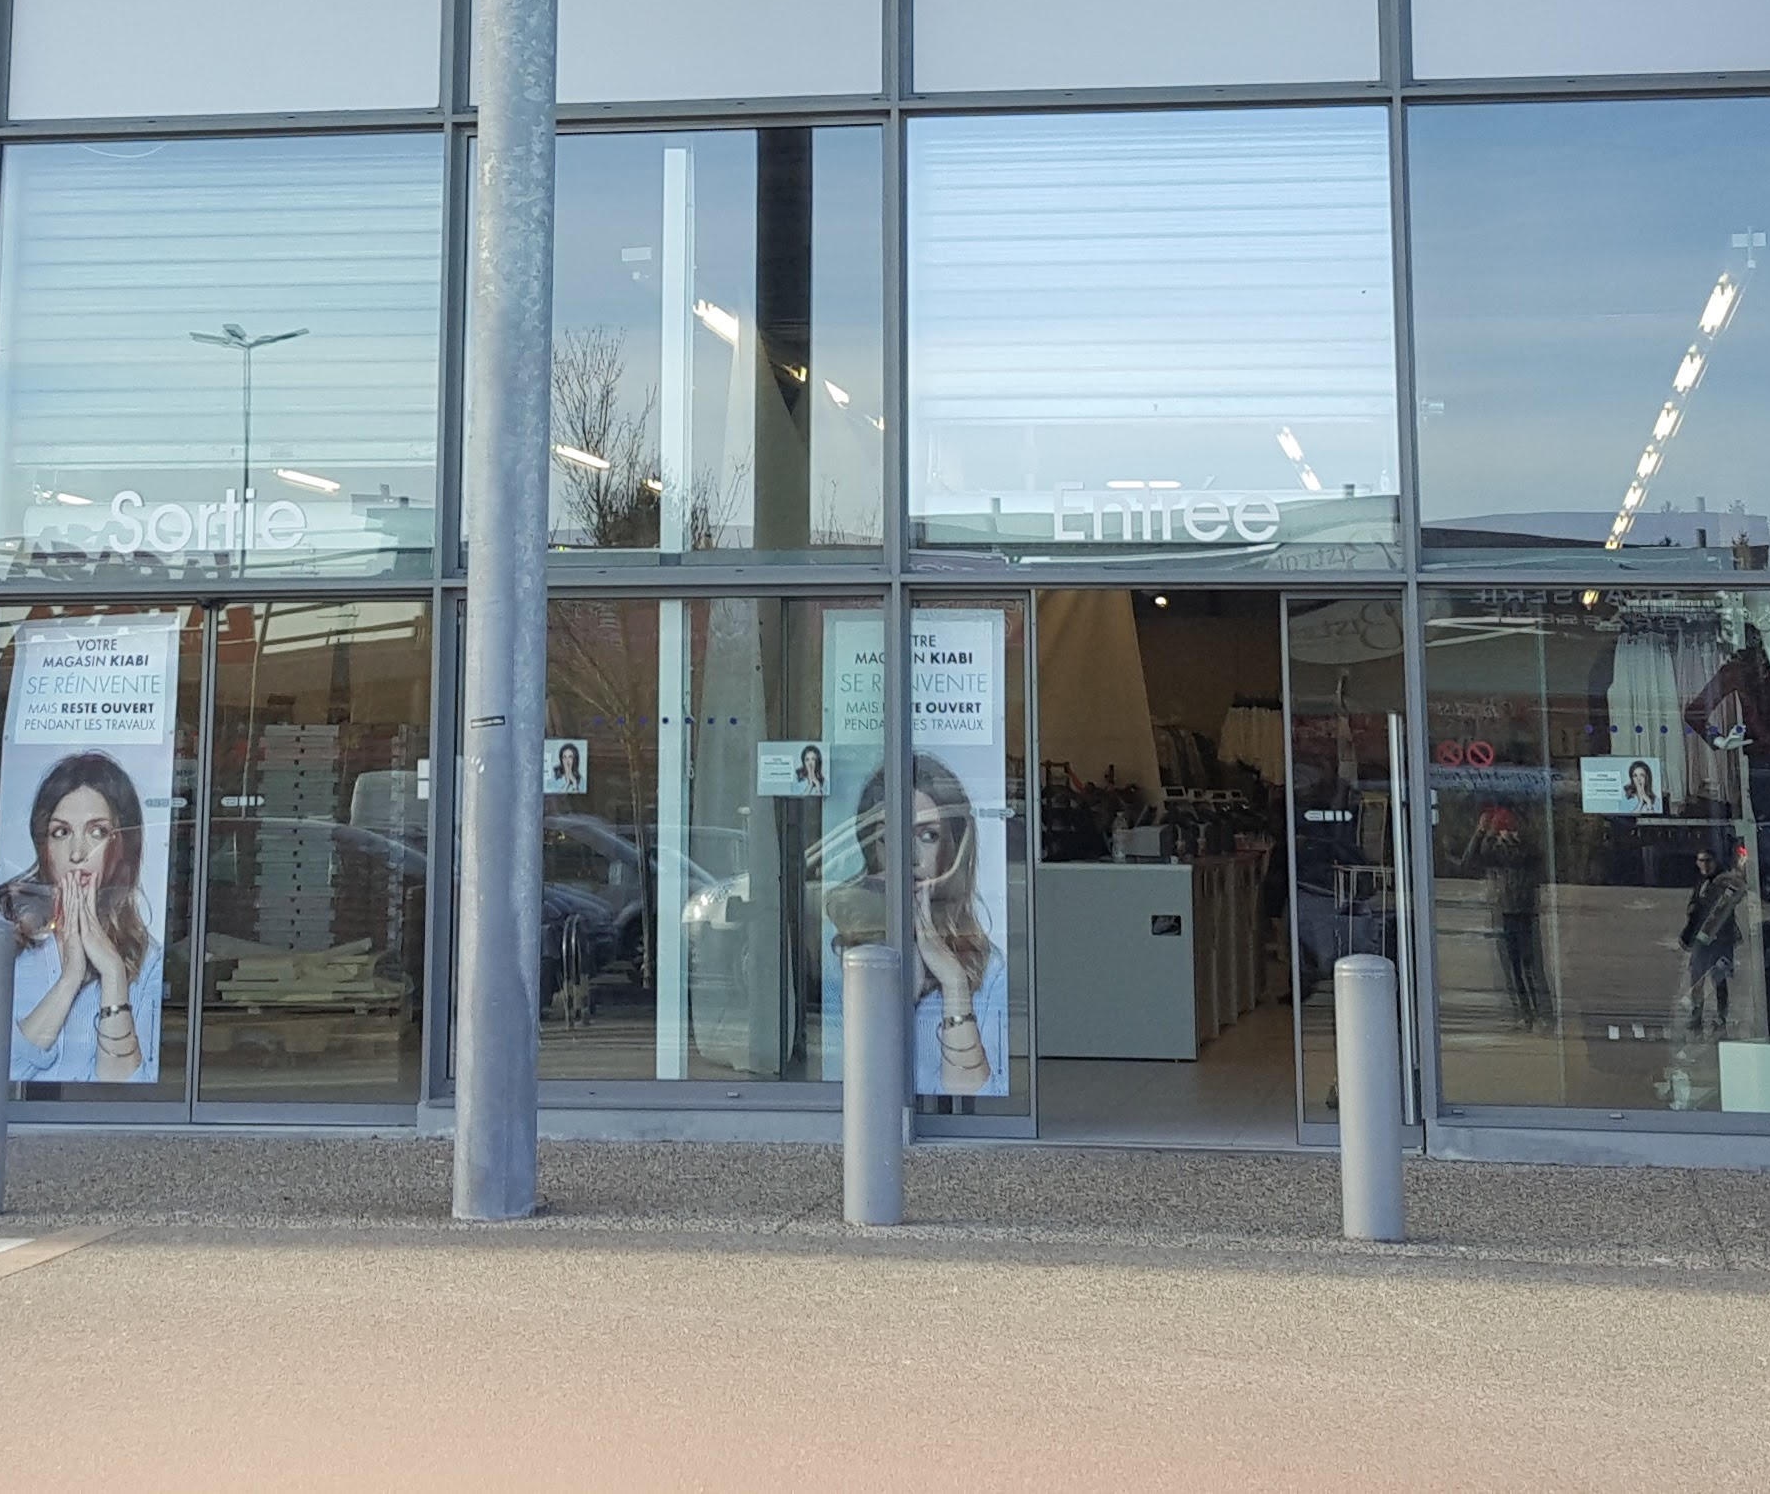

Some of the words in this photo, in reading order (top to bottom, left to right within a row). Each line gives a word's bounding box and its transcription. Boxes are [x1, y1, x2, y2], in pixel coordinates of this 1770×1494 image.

[1052, 474, 1281, 543] Entrée
[108, 487, 307, 554] Sortie
[77, 638, 118, 651] VOTRE
[910, 634, 936, 647] TRE
[42, 655, 106, 668] MAGASIN
[109, 654, 149, 667] KIABI
[930, 652, 973, 664] KIABI
[26, 676, 49, 695] SE
[54, 672, 161, 694] RÉINVENTE
[840, 673, 864, 693] SE
[28, 703, 58, 714] MAIS
[61, 702, 98, 714] RESTE
[101, 702, 155, 714] OUVERT
[845, 702, 879, 713] MAIS
[925, 702, 982, 713] OUVERT
[24, 718, 83, 731] PENDANT
[84, 718, 102, 730] LES
[106, 718, 156, 730] TRAVAUX
[844, 718, 885, 730] PENDA
[913, 718, 927, 730] ES
[931, 718, 984, 731] TRAVAUX
